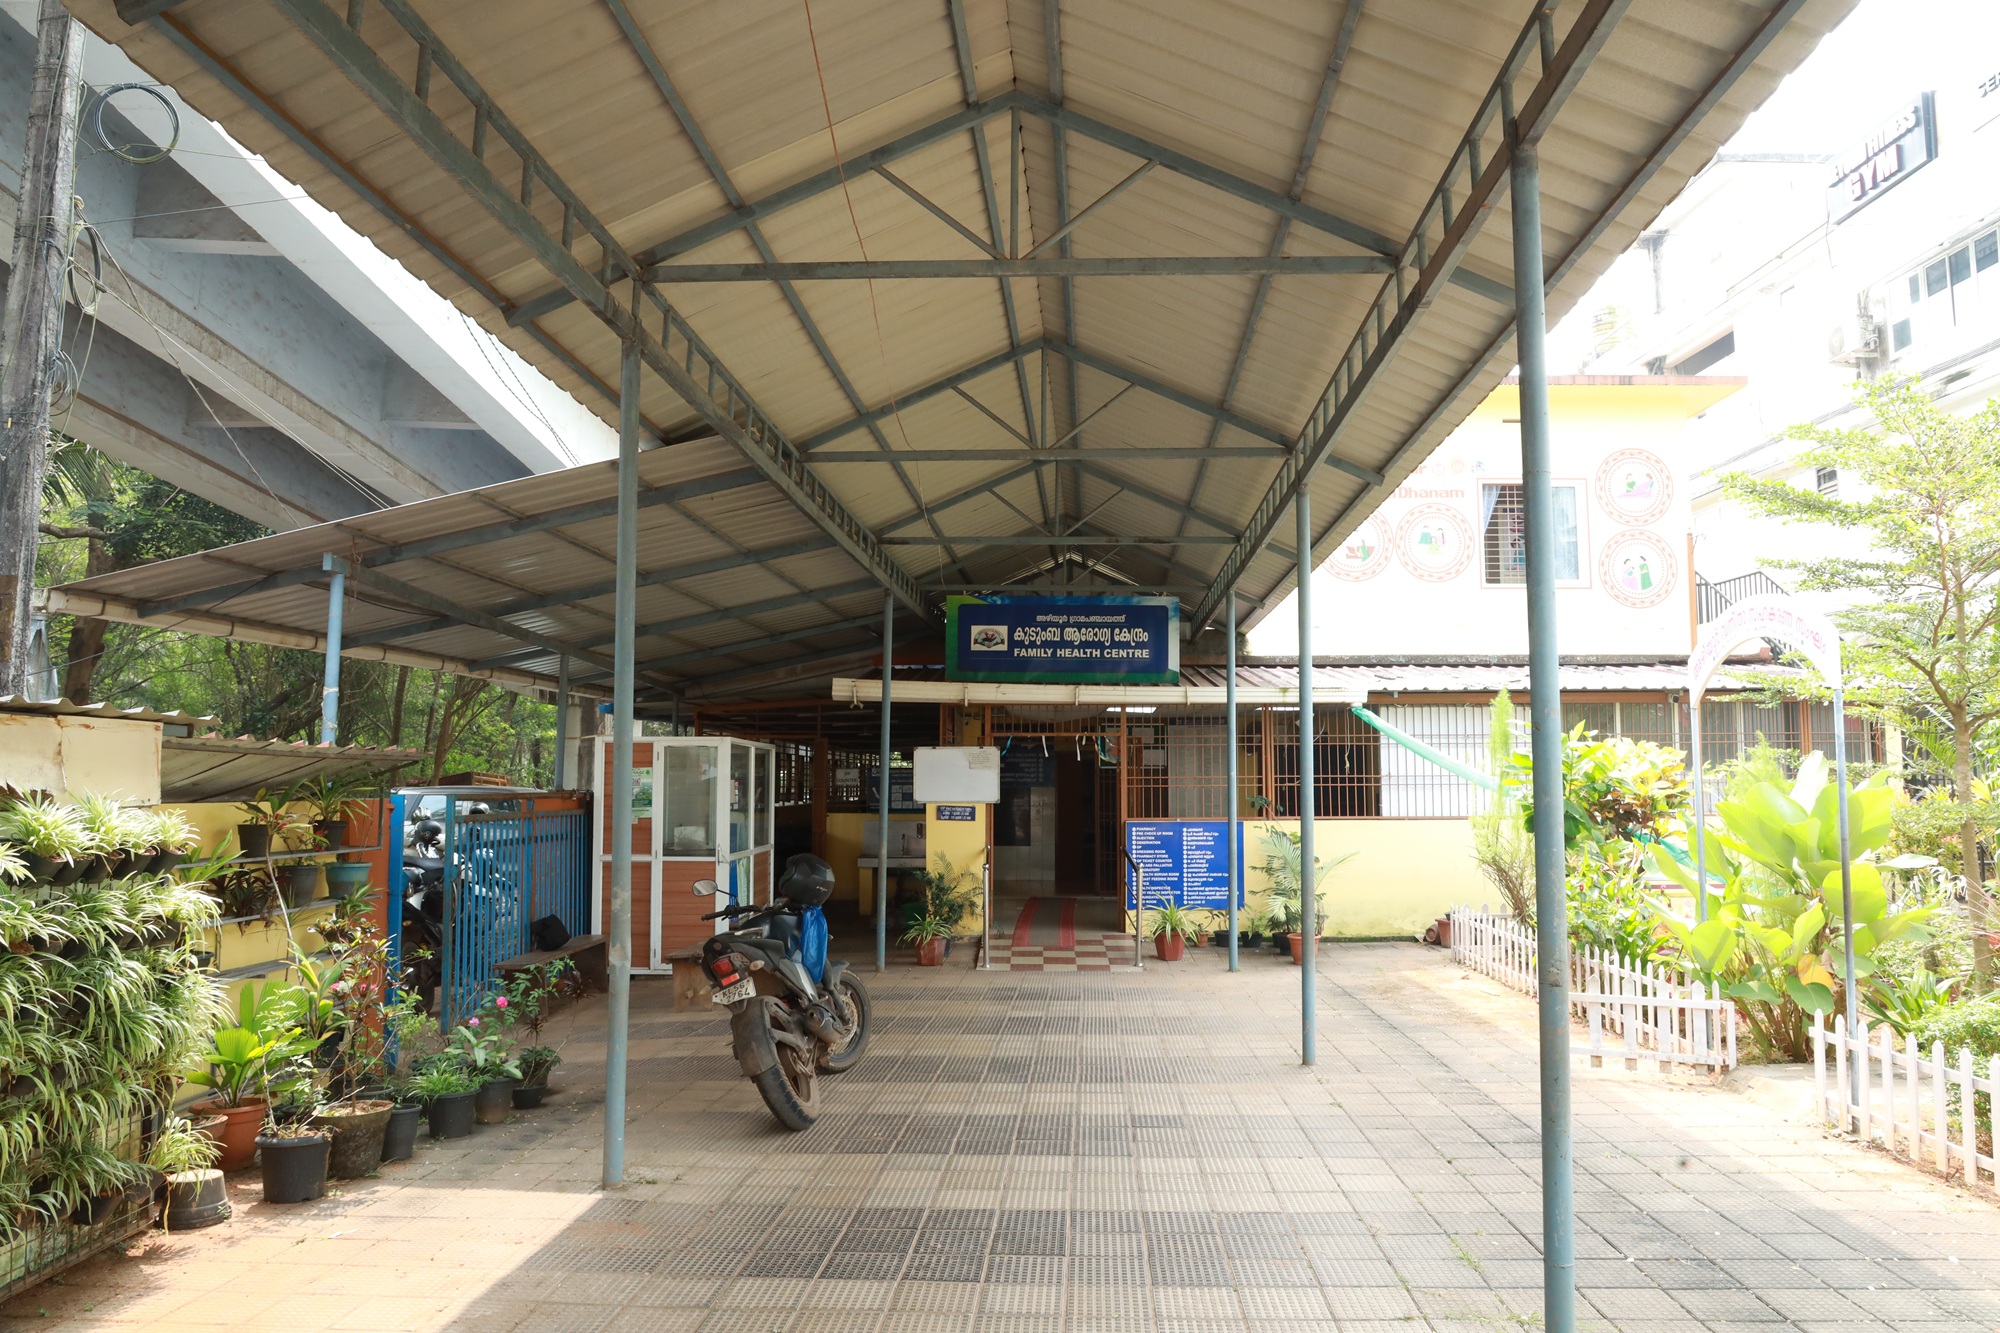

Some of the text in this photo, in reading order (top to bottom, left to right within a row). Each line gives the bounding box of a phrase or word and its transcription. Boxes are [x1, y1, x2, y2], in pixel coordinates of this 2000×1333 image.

[1847, 143, 1901, 202] GYM
[1013, 626, 1061, 646] കുടുംബ
[1063, 627, 1111, 646] ആരോഗ്യ
[1014, 648, 1150, 658] FAMILY HEALTH CENTRE
[726, 987, 750, 1004] 2764
